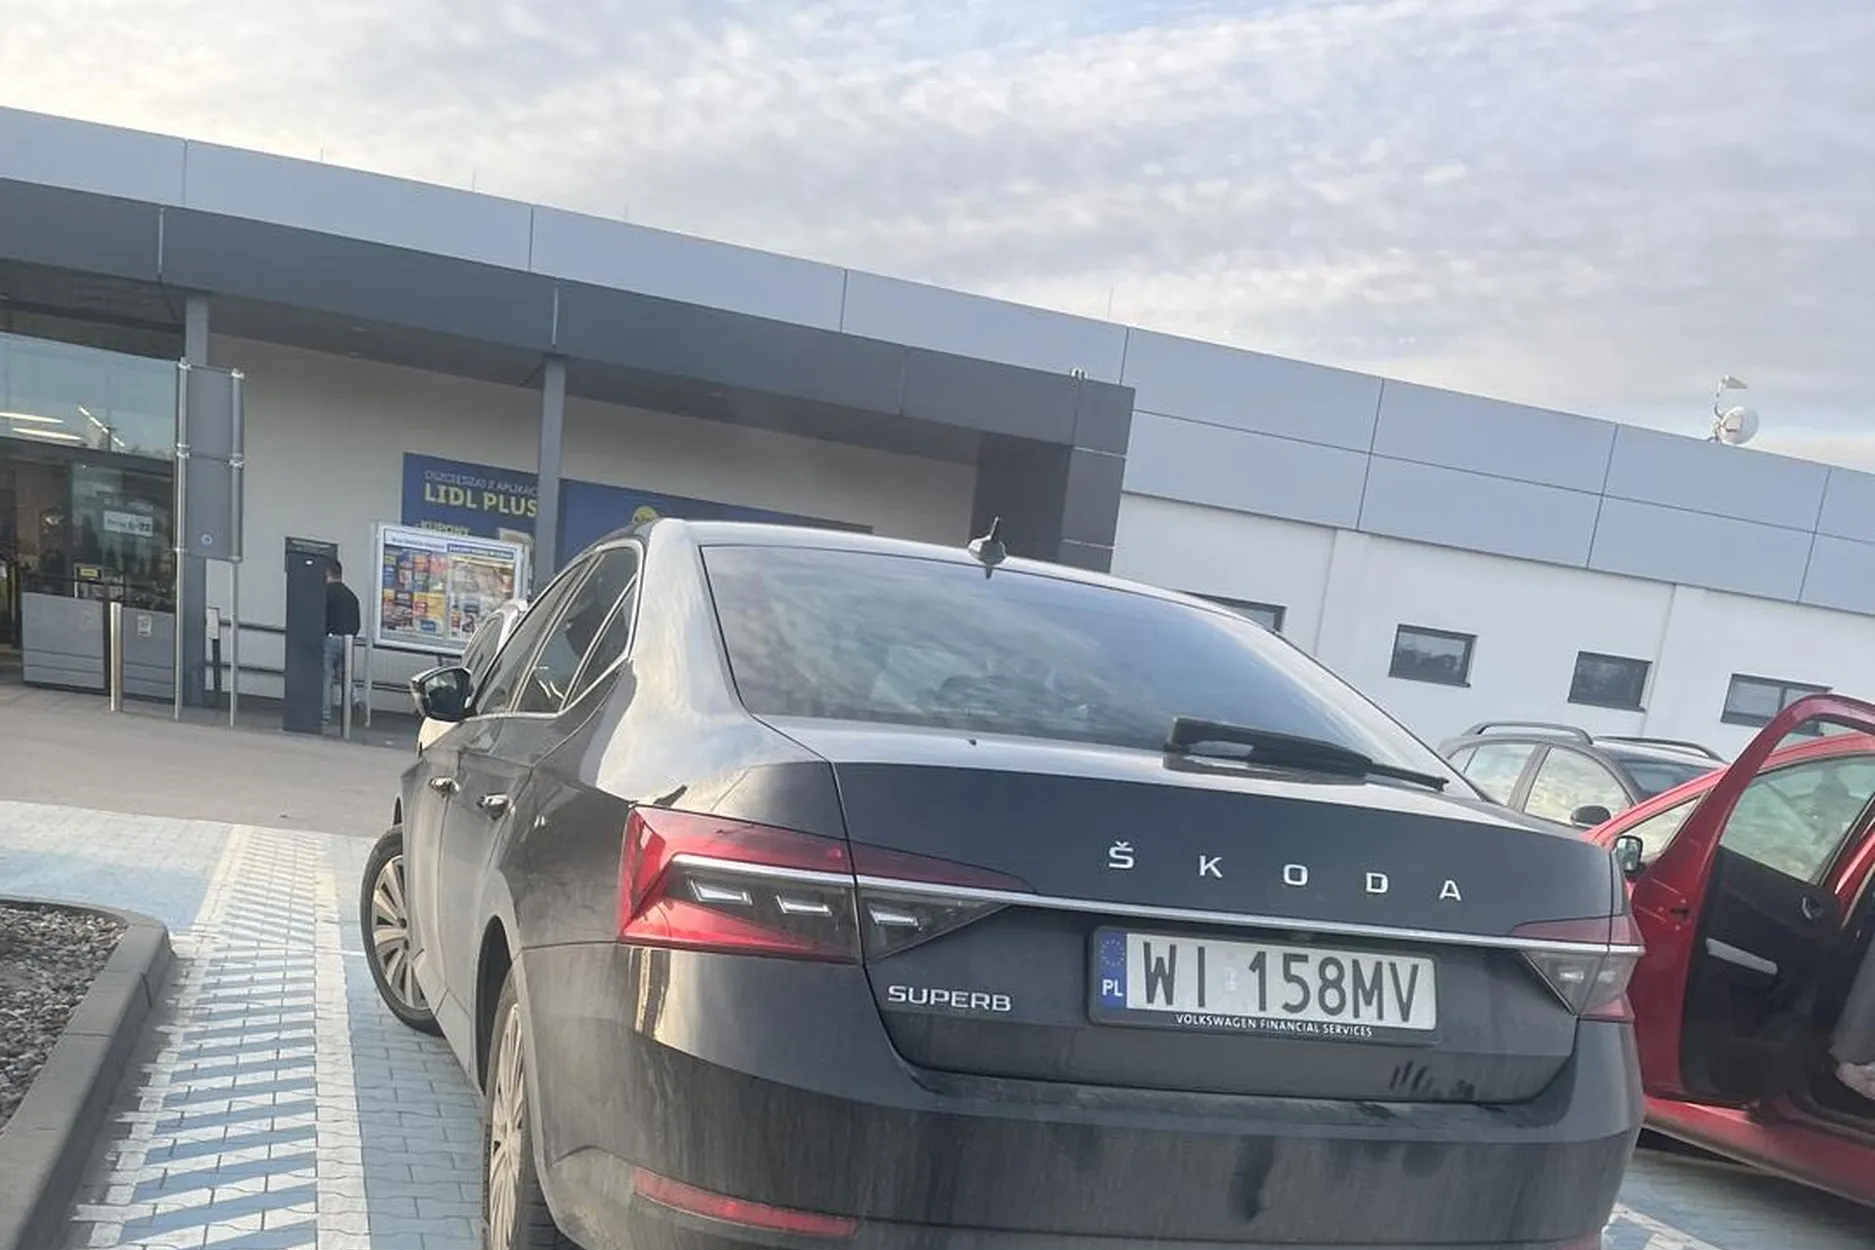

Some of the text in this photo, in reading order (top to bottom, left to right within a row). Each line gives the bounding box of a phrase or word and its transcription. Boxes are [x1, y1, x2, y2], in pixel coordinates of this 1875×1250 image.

[424, 482, 537, 517] LIDL PLUS
[1108, 841, 1462, 902] ŠKODA
[1102, 978, 1124, 998] PL
[1143, 941, 1419, 1022] WI 158MV
[888, 985, 1012, 1012] SUPERB
[1175, 1013, 1373, 1038] VOLKSWAGEN FINANCIAL SERVICES
